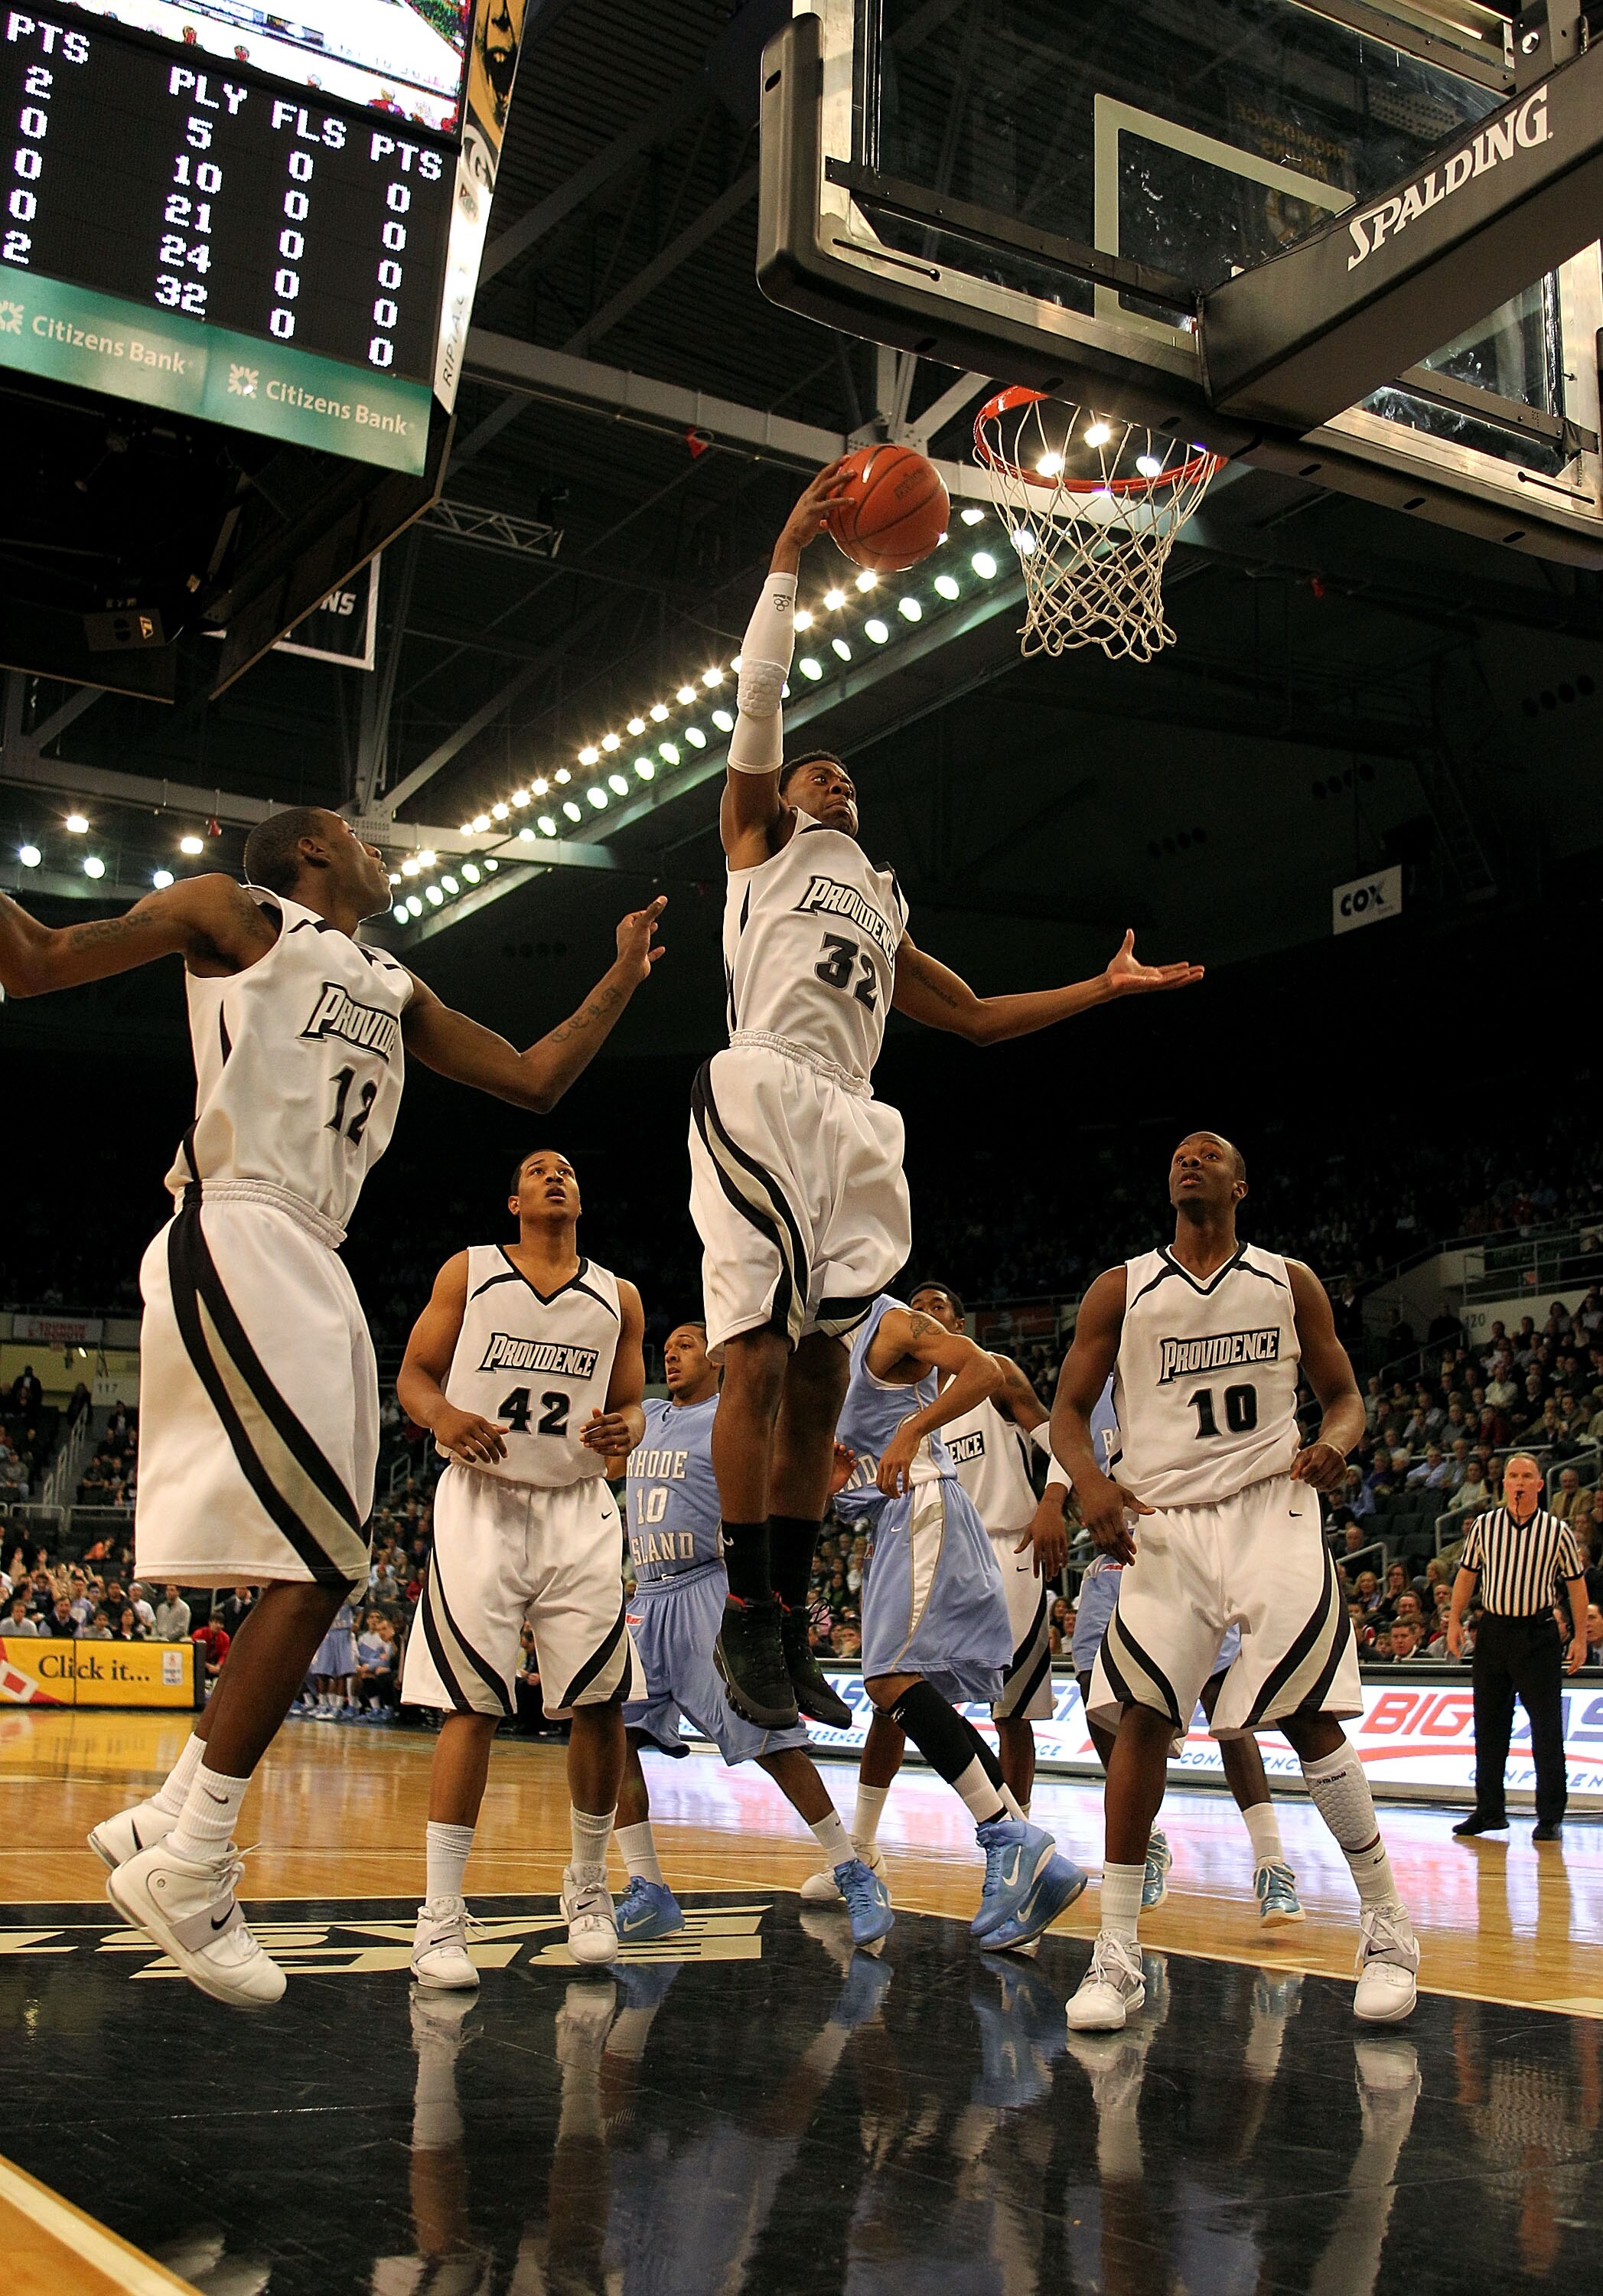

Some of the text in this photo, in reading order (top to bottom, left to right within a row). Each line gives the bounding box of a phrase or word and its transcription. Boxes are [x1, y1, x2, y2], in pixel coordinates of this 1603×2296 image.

[7, 11, 90, 64] PTS
[24, 65, 54, 99] 2
[20, 106, 48, 139] 0
[168, 66, 442, 181] PLY FLS PTS
[14, 148, 43, 181] 0
[186, 116, 411, 214] 5 0 0
[1347, 84, 1549, 272] SPALDING
[8, 188, 37, 222] 0
[173, 155, 407, 252] 10 0 0
[2, 230, 32, 265] 2
[165, 194, 402, 290] 21 0 0
[159, 233, 399, 329] 24 0 0
[32, 315, 187, 375] Citizens Bank
[155, 274, 394, 367] 32 0 0
[266, 380, 408, 435] Citizens Bank
[1341, 879, 1385, 917] COX
[814, 931, 878, 1015] 32
[303, 983, 398, 1058] PROVID
[324, 1065, 377, 1146] 12
[477, 1332, 599, 1381] PROVIDENCE
[1157, 1329, 1279, 1385] PROVIDENCE
[497, 1386, 571, 1437] 42
[1187, 1382, 1259, 1440] 10
[626, 1449, 689, 1480] RHODE
[636, 1486, 670, 1526] 10
[631, 1531, 695, 1567] SLAND
[38, 1655, 104, 1681] Click
[1359, 1692, 1474, 1737] BIG
